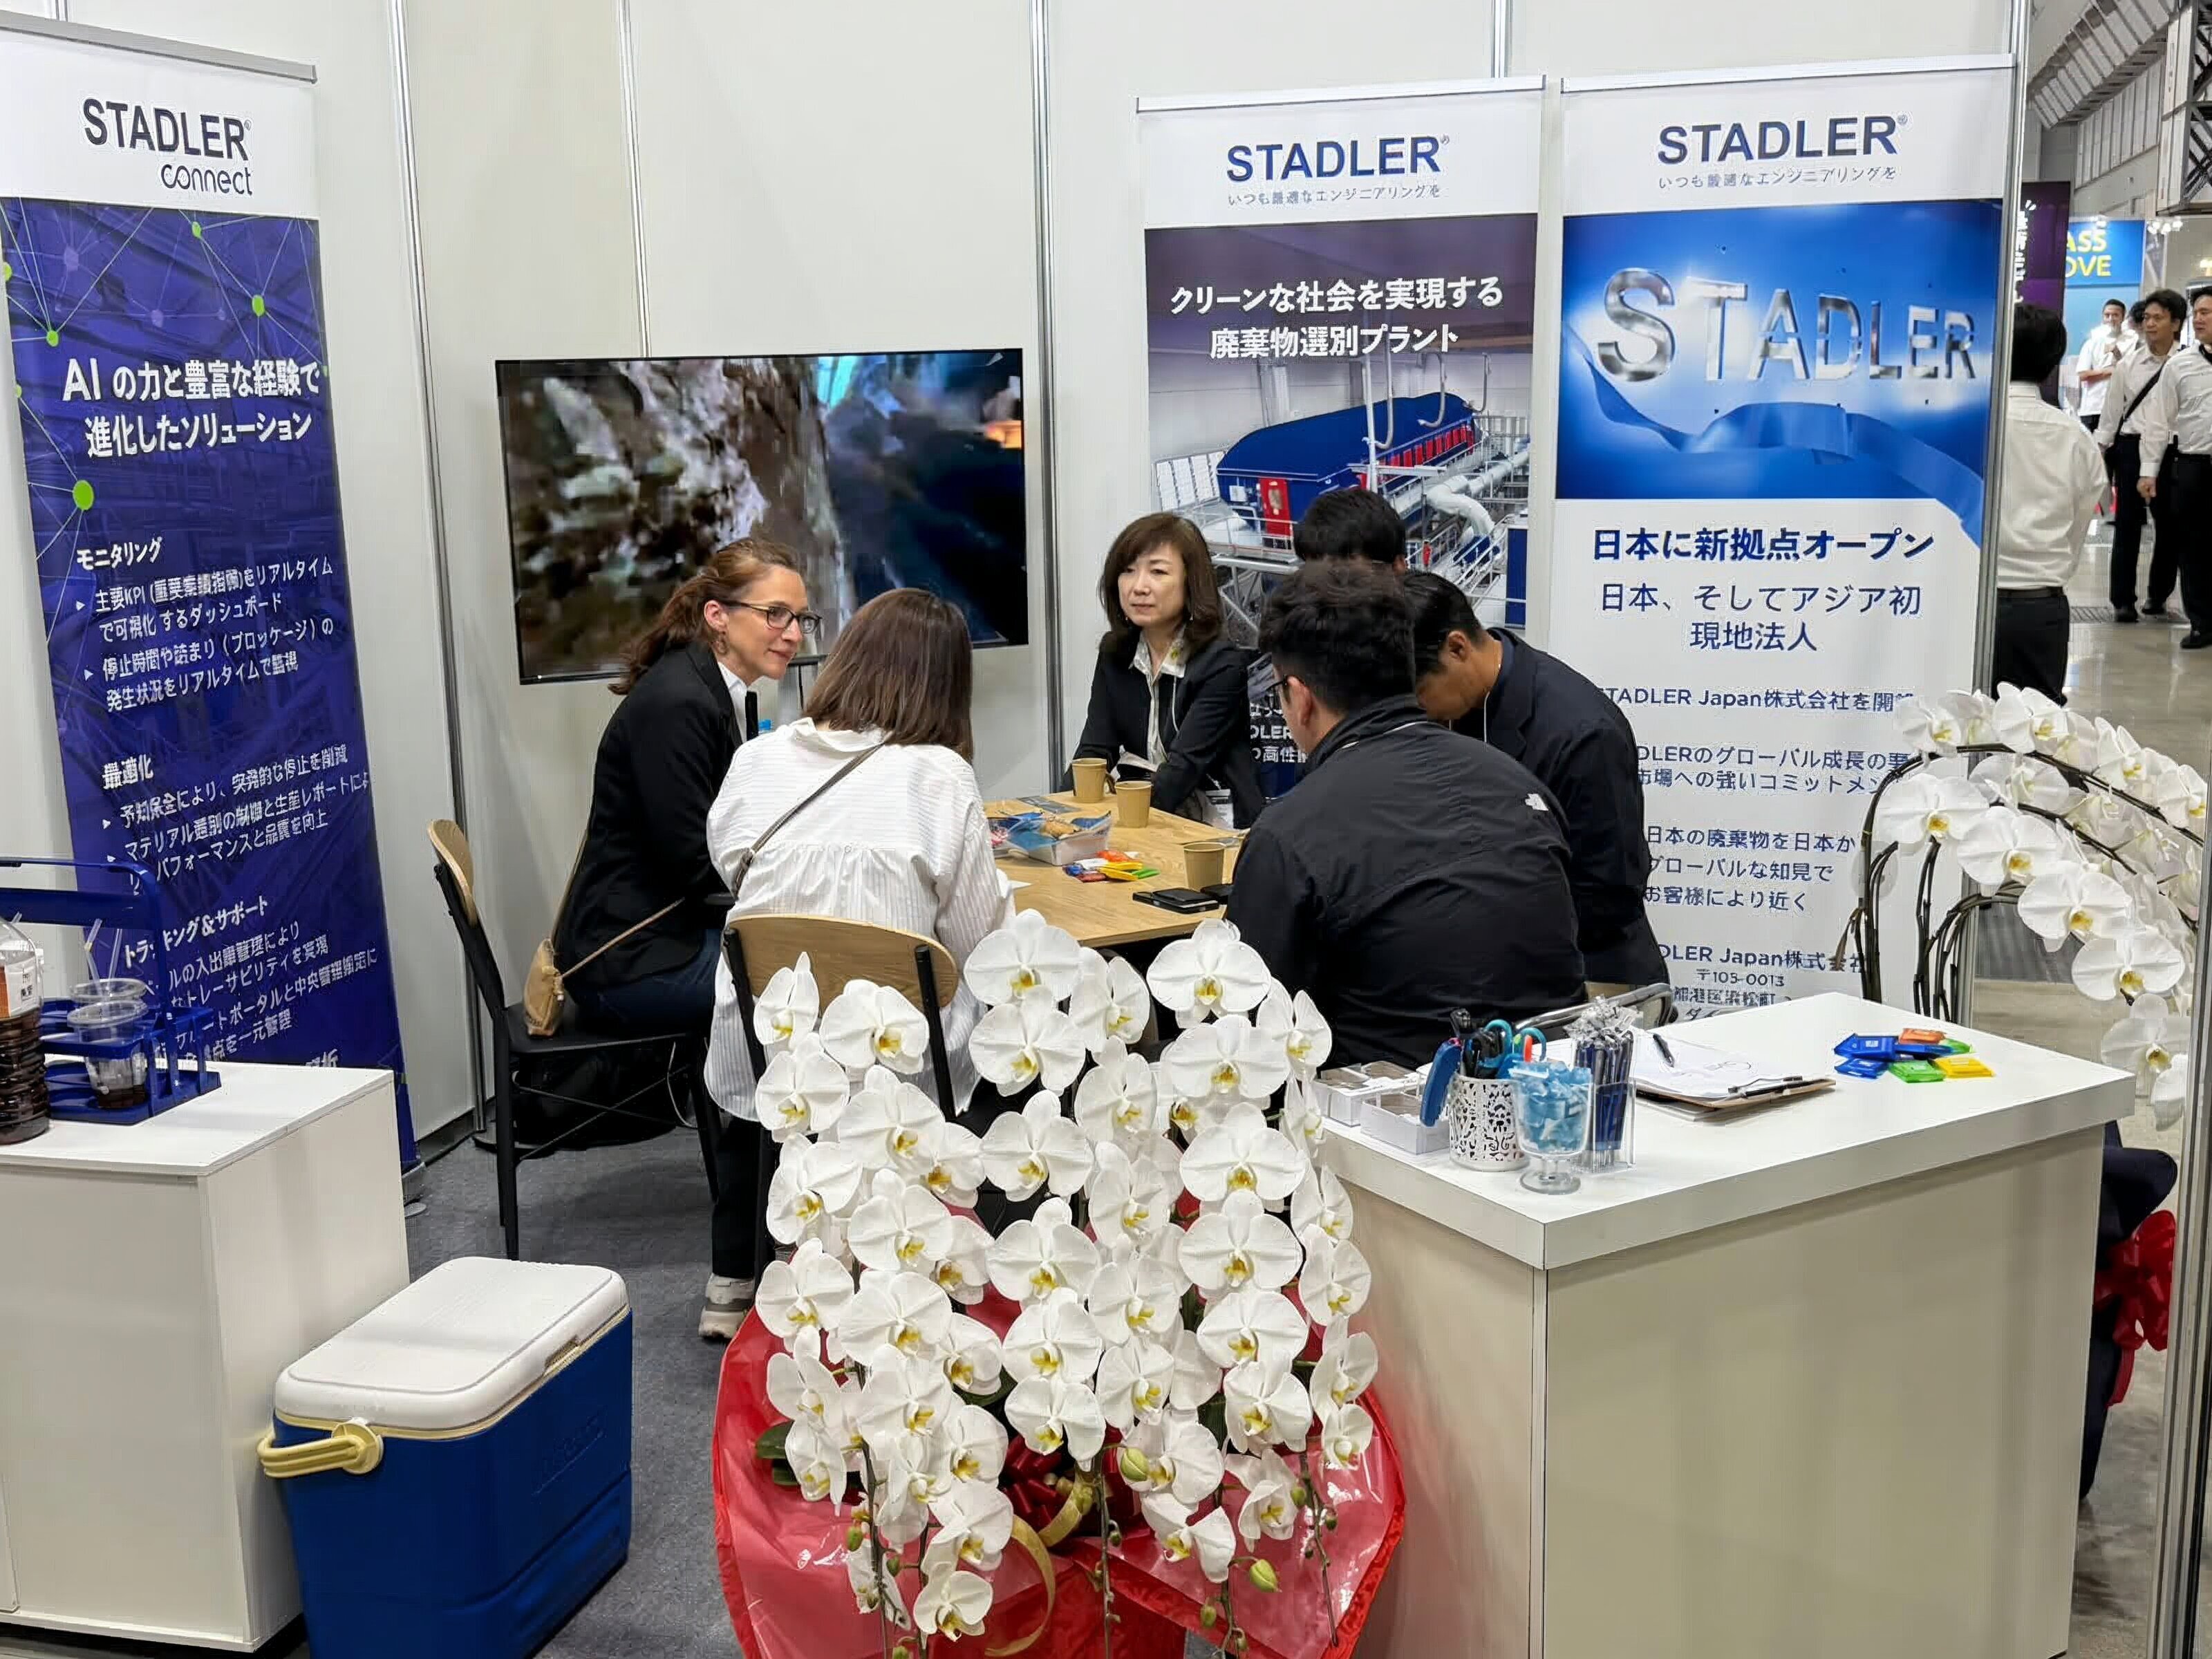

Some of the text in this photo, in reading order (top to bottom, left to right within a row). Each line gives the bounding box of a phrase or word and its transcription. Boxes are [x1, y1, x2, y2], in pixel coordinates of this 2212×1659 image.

[82, 97, 250, 162] STADLER
[1658, 115, 1898, 165] STADLER
[1226, 135, 1441, 182] STADLER
[160, 163, 253, 196] connect
[1170, 276, 1504, 315] クリーンな社会を実現する
[1210, 324, 1459, 360] 廃棄物選別プラント
[1597, 267, 1976, 383] STADLER
[84, 412, 313, 459] 進化したソリューション
[75, 536, 163, 571] モニタリング
[1593, 527, 1936, 562] 日本に新拠点オープン
[1689, 621, 1818, 652] 現地法人
[1600, 688, 1913, 713] TADLER Japan株式会社を開
